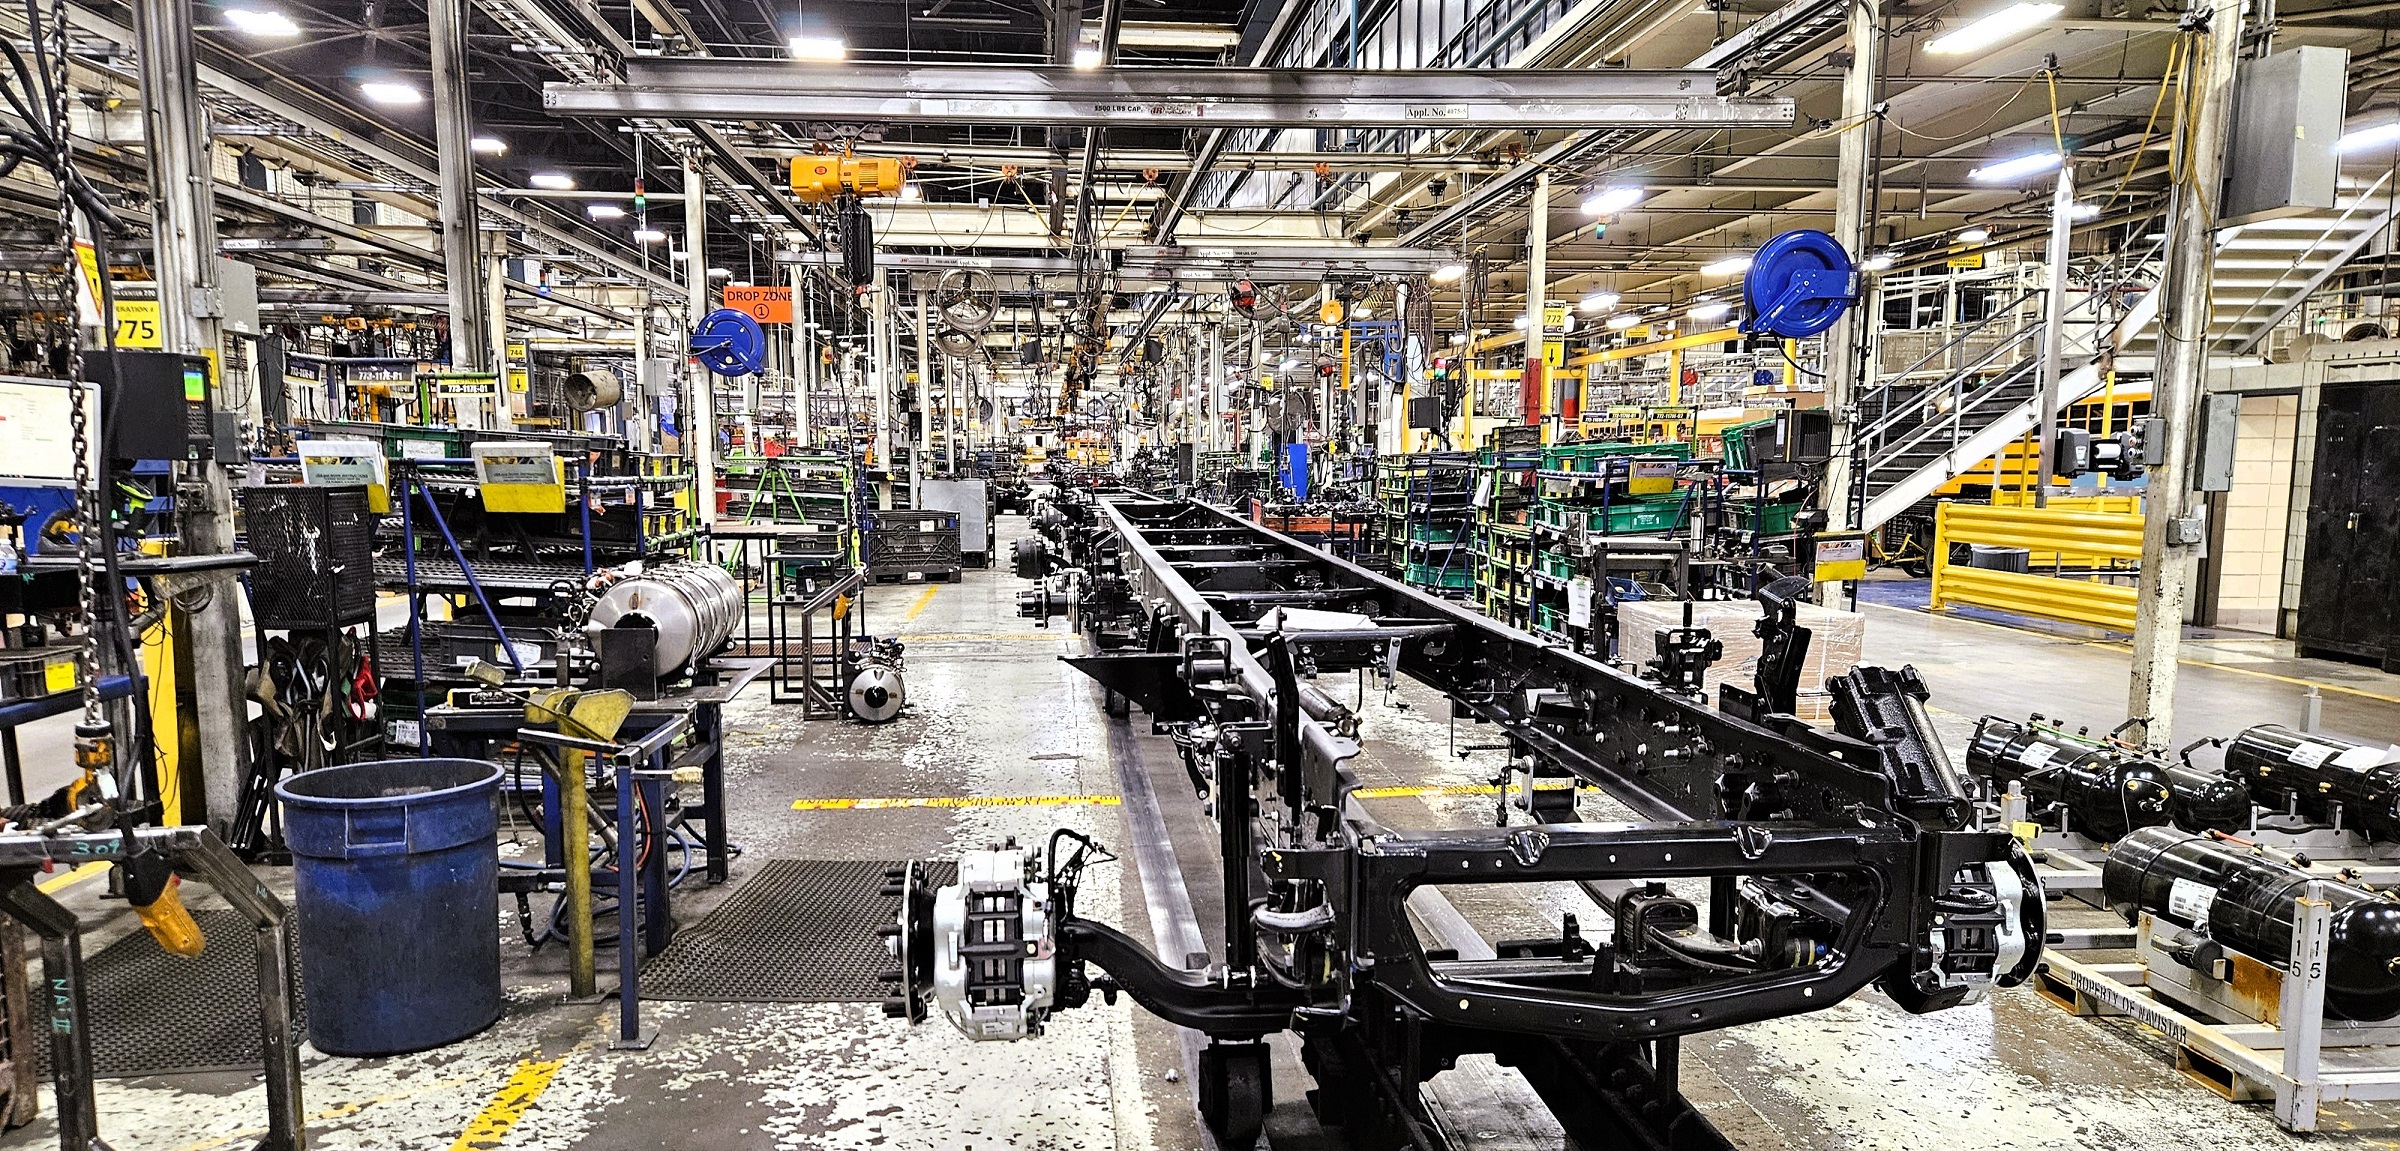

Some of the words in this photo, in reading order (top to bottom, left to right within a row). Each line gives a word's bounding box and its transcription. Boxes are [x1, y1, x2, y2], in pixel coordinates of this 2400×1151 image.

[1407, 108, 1429, 118] Appl.
[1431, 108, 1446, 116] No.
[727, 291, 760, 301] DROP
[762, 291, 792, 302] ZONE
[115, 305, 148, 313] ERATION
[1546, 315, 1562, 323] 772
[71, 838, 120, 856] 309
[2070, 970, 2119, 1005] PROPERTY
[2122, 996, 2136, 1016] OF
[2138, 1004, 2187, 1044] NAVISTAR
